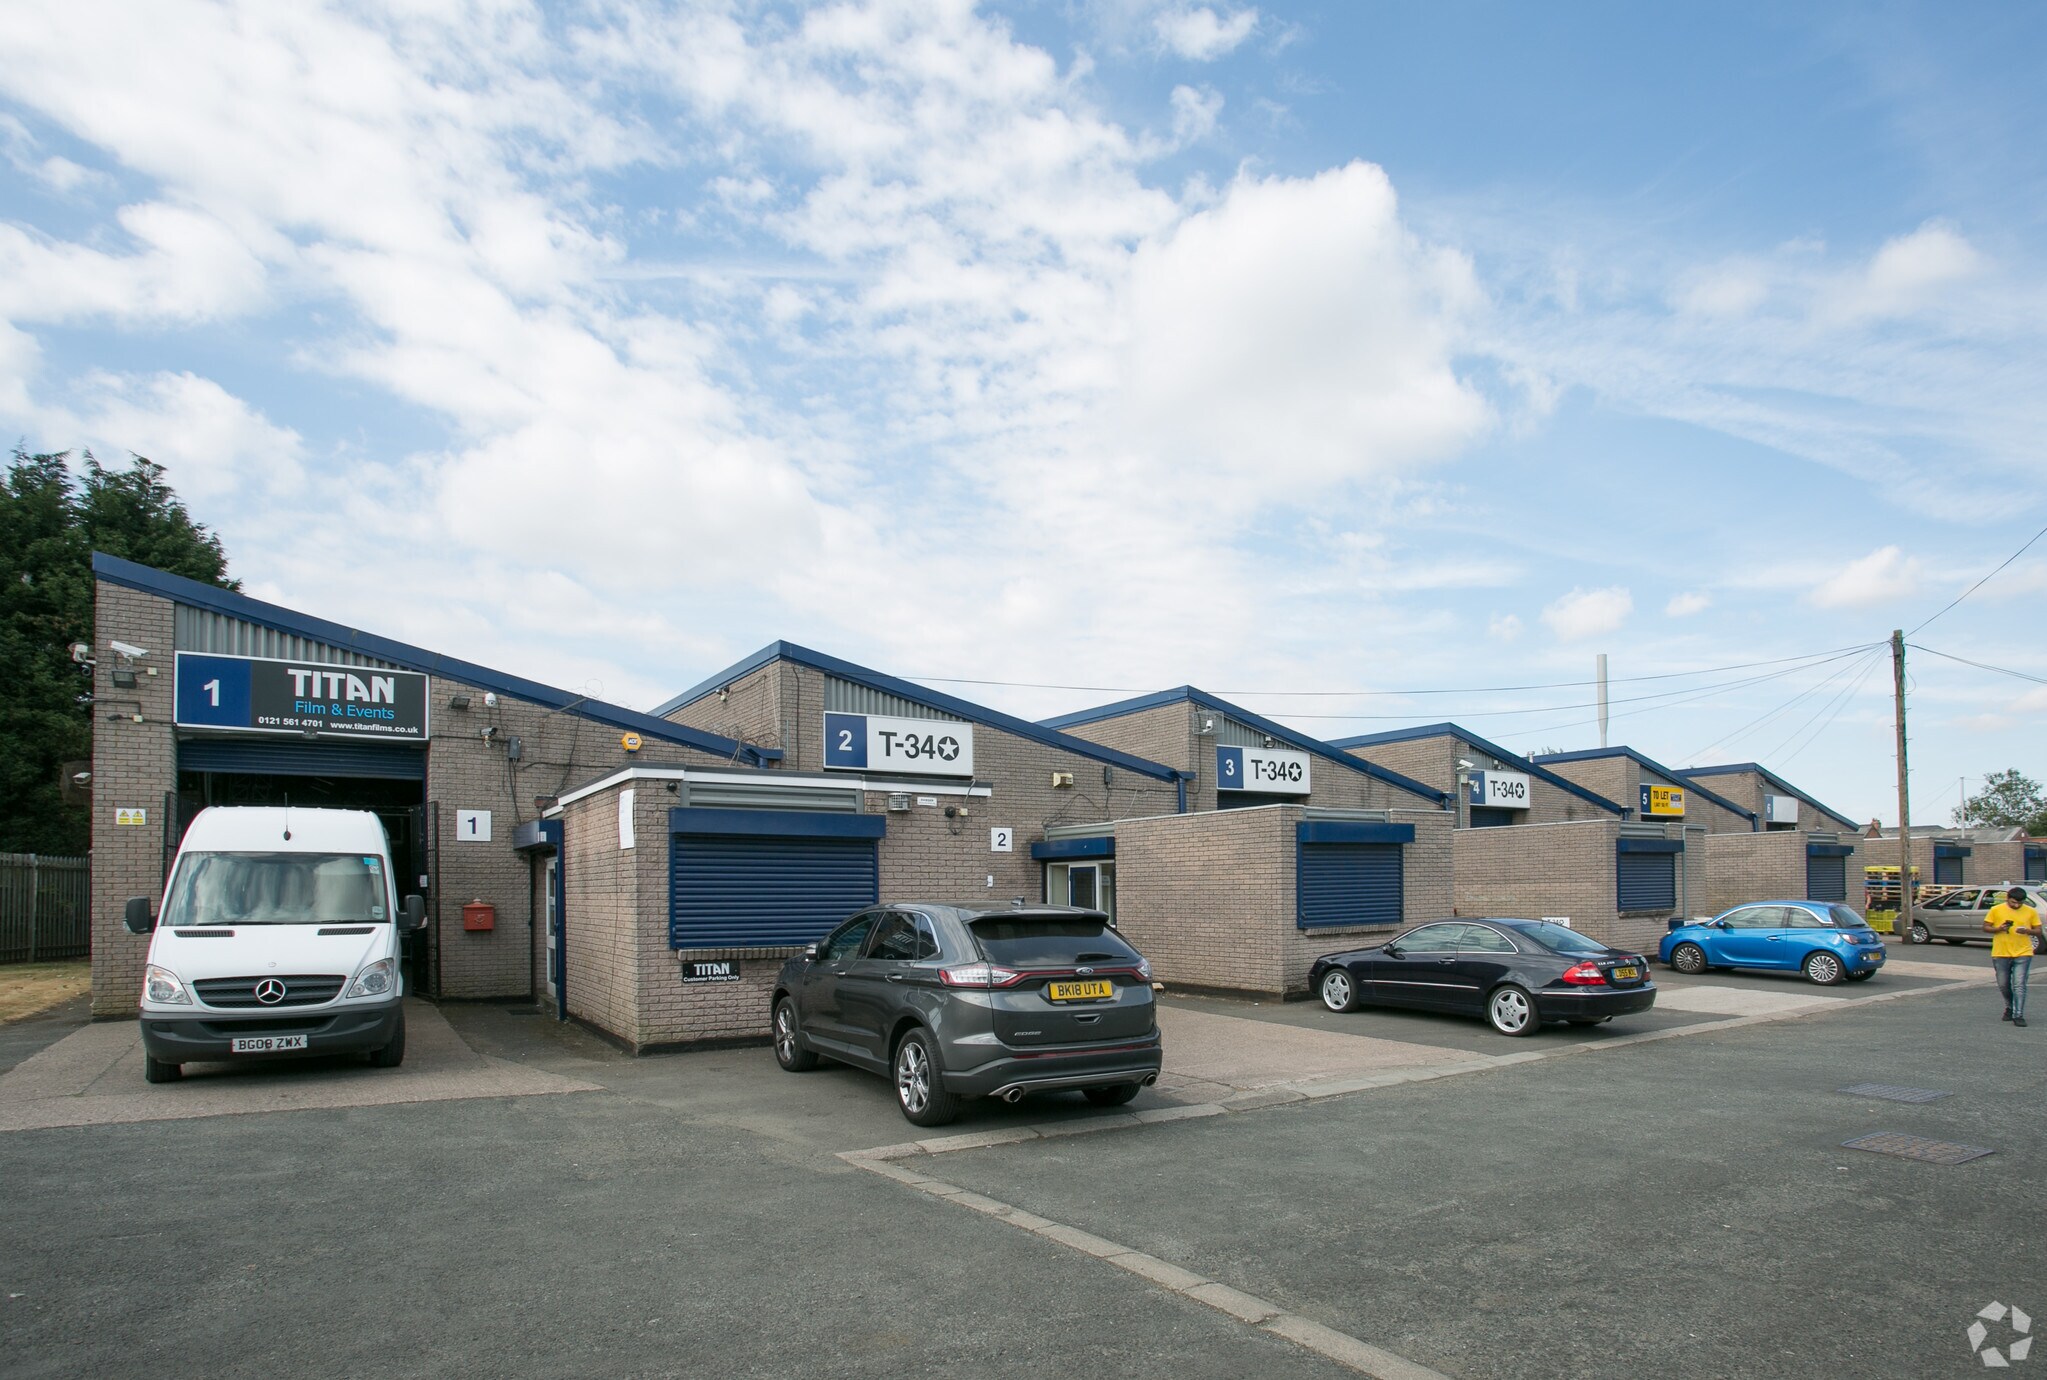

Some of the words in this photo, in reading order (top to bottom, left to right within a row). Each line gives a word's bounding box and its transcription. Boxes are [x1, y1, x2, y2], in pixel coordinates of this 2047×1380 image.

[203, 679, 220, 706] 1
[287, 668, 395, 704] TITAN
[295, 700, 326, 715] Film
[331, 703, 343, 717] &
[347, 704, 395, 720] Events
[258, 716, 280, 725] 0121
[283, 718, 299, 727] 561
[301, 719, 323, 728] 4701
[330, 721, 418, 734] www.titanfilms.co.uk
[838, 729, 853, 751] 2
[1225, 758, 1235, 776] 3
[1642, 793, 1648, 805] 5
[1653, 790, 1659, 800] TO
[1660, 790, 1669, 800] LET
[467, 816, 477, 835] 1
[997, 832, 1006, 847] 2
[693, 962, 730, 976] TITAN
[1057, 984, 1082, 997] BK18
[1084, 983, 1105, 995] UTA
[276, 1036, 302, 1048] ZWX
